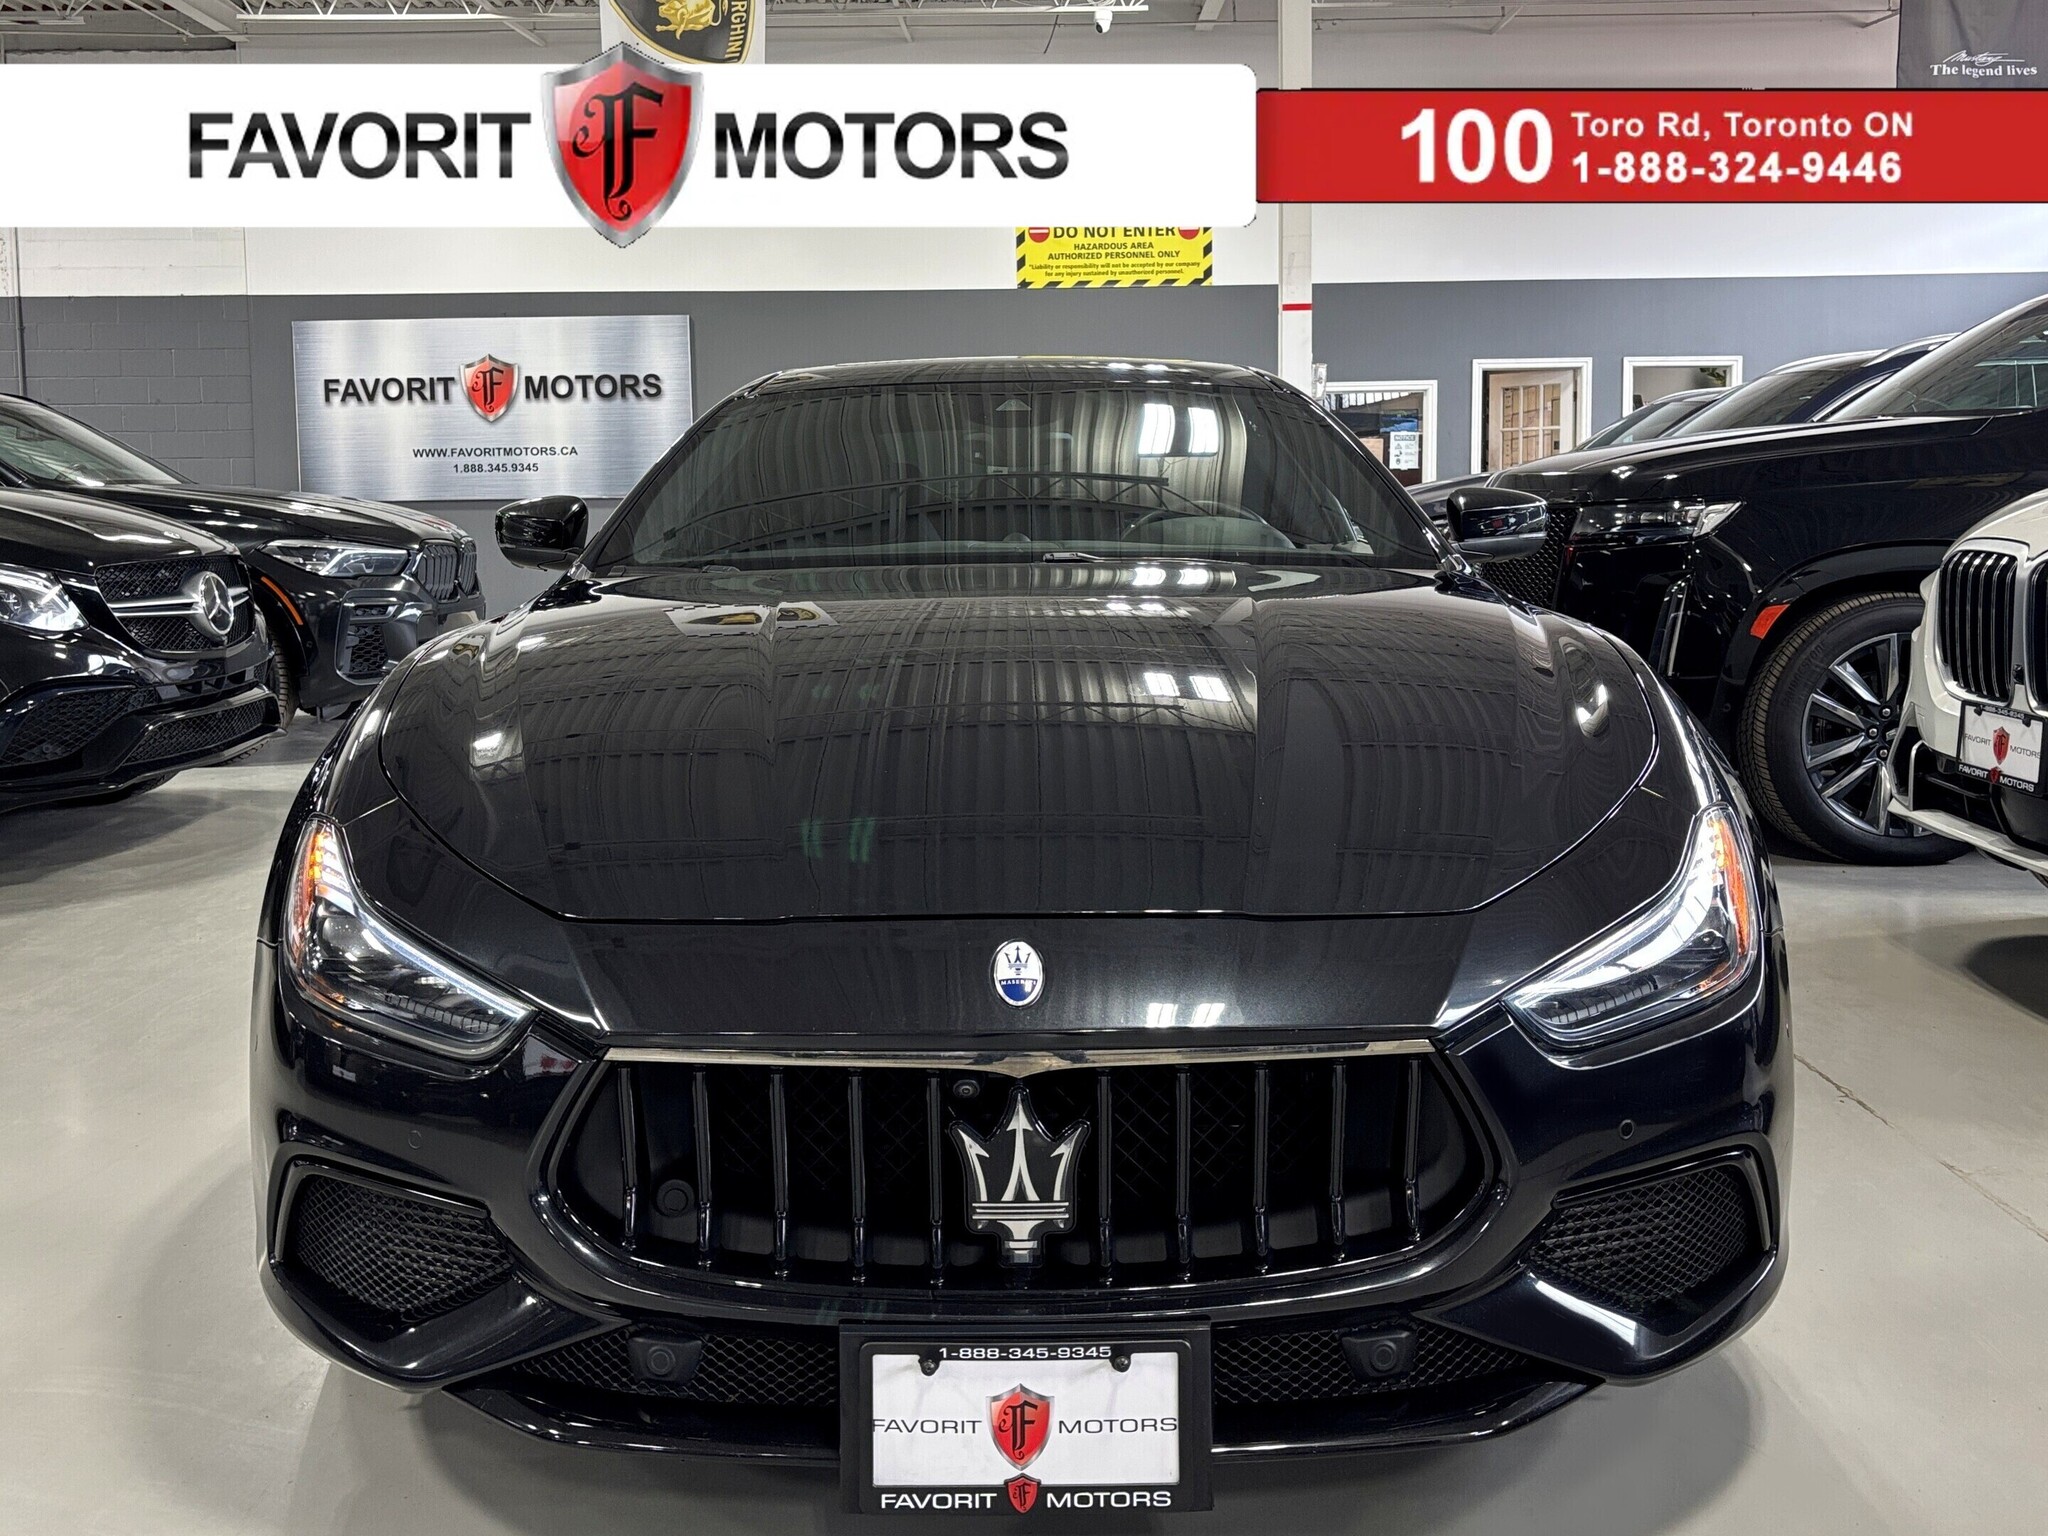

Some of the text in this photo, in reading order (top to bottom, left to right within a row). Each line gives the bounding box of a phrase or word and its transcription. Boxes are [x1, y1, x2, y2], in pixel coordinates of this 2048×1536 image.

[1943, 50, 2025, 67] Mustang
[1930, 64, 2038, 79] The legend lives
[1054, 226, 1176, 239] DO NOT ENTER
[1073, 243, 1128, 251] HAZARDOUS
[1048, 250, 1181, 260] AUTHORIZED PERSONNEL ONLY
[323, 377, 455, 403] FAVORIT
[524, 374, 663, 400] MOTORS
[412, 446, 579, 458] WWW.FAVORITMOTORS.CA
[453, 463, 539, 474] 1.888.345.9345
[1964, 733, 1992, 746] FAVORIT
[2010, 745, 2041, 759] MOTORS
[1958, 764, 2035, 792] FAVORIT MOTORS
[939, 1346, 1112, 1359] 1-888-345-9345
[872, 1418, 983, 1434] FAVORIT
[1058, 1417, 1178, 1434] MOTORS
[880, 1492, 998, 1509] FAVORIT
[1046, 1491, 1172, 1508] MOTORS
